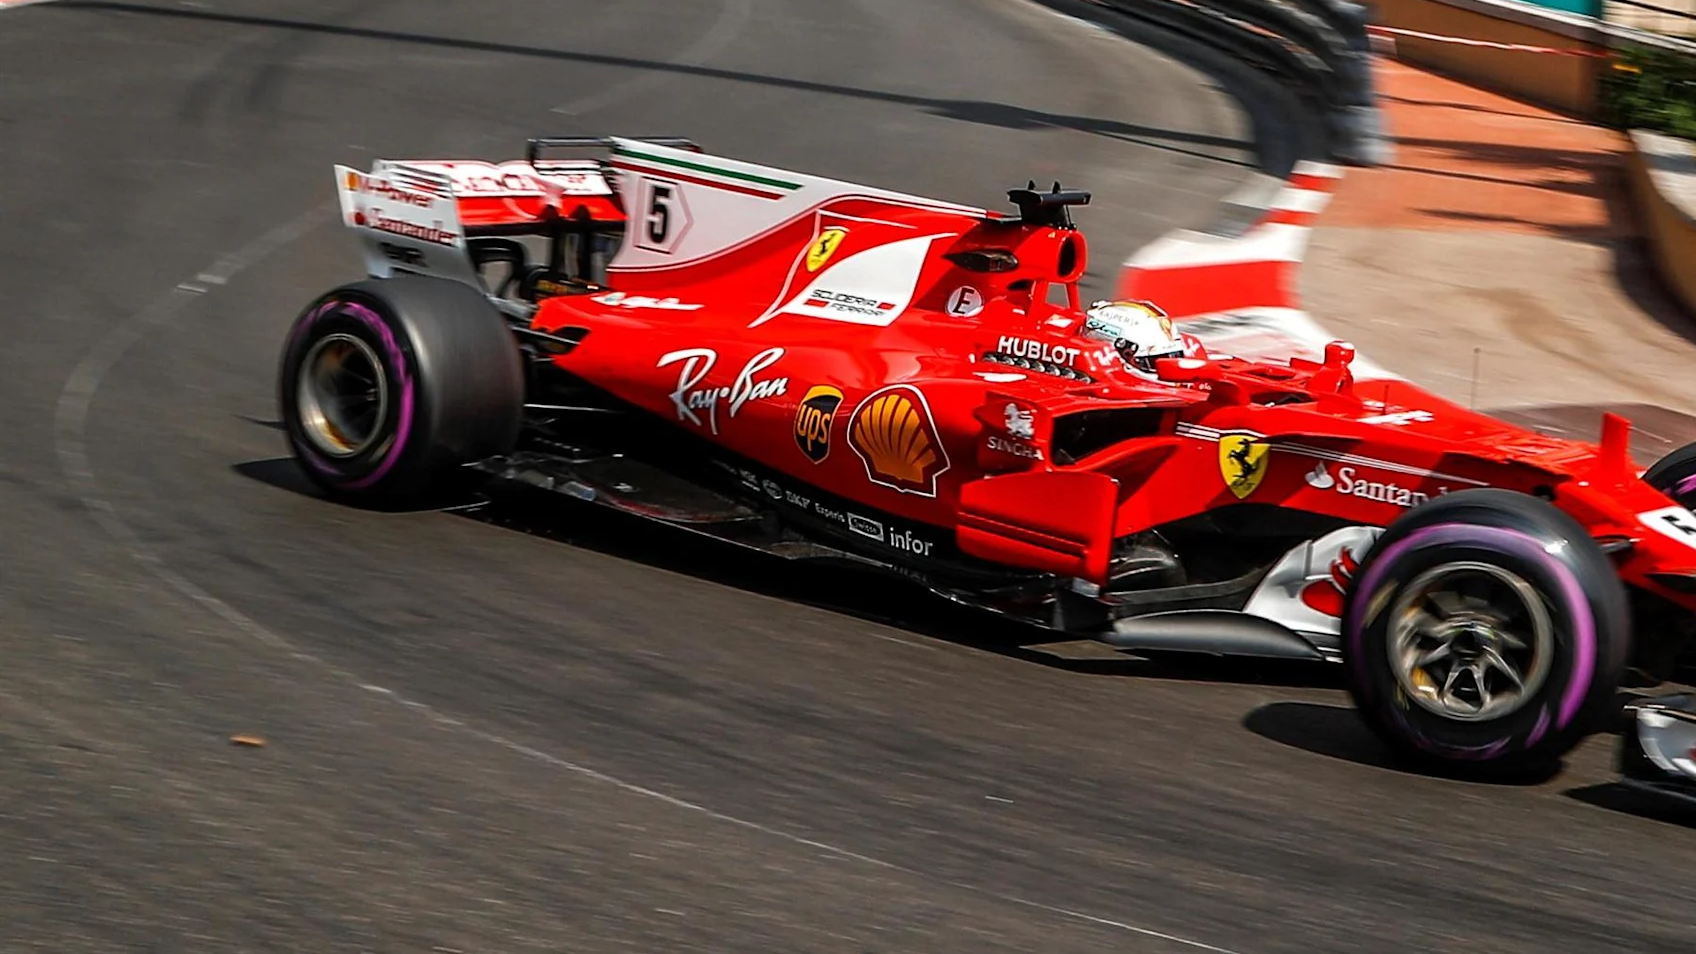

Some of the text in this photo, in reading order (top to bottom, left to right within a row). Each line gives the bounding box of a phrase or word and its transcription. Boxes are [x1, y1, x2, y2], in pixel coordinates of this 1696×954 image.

[647, 186, 671, 244] 5
[811, 289, 878, 307] SCUDERIA
[952, 287, 975, 315] E
[997, 335, 1081, 366] HUBLOT
[987, 436, 1045, 460] SINGHA
[1336, 467, 1448, 508] Santan
[889, 527, 934, 556] infor
